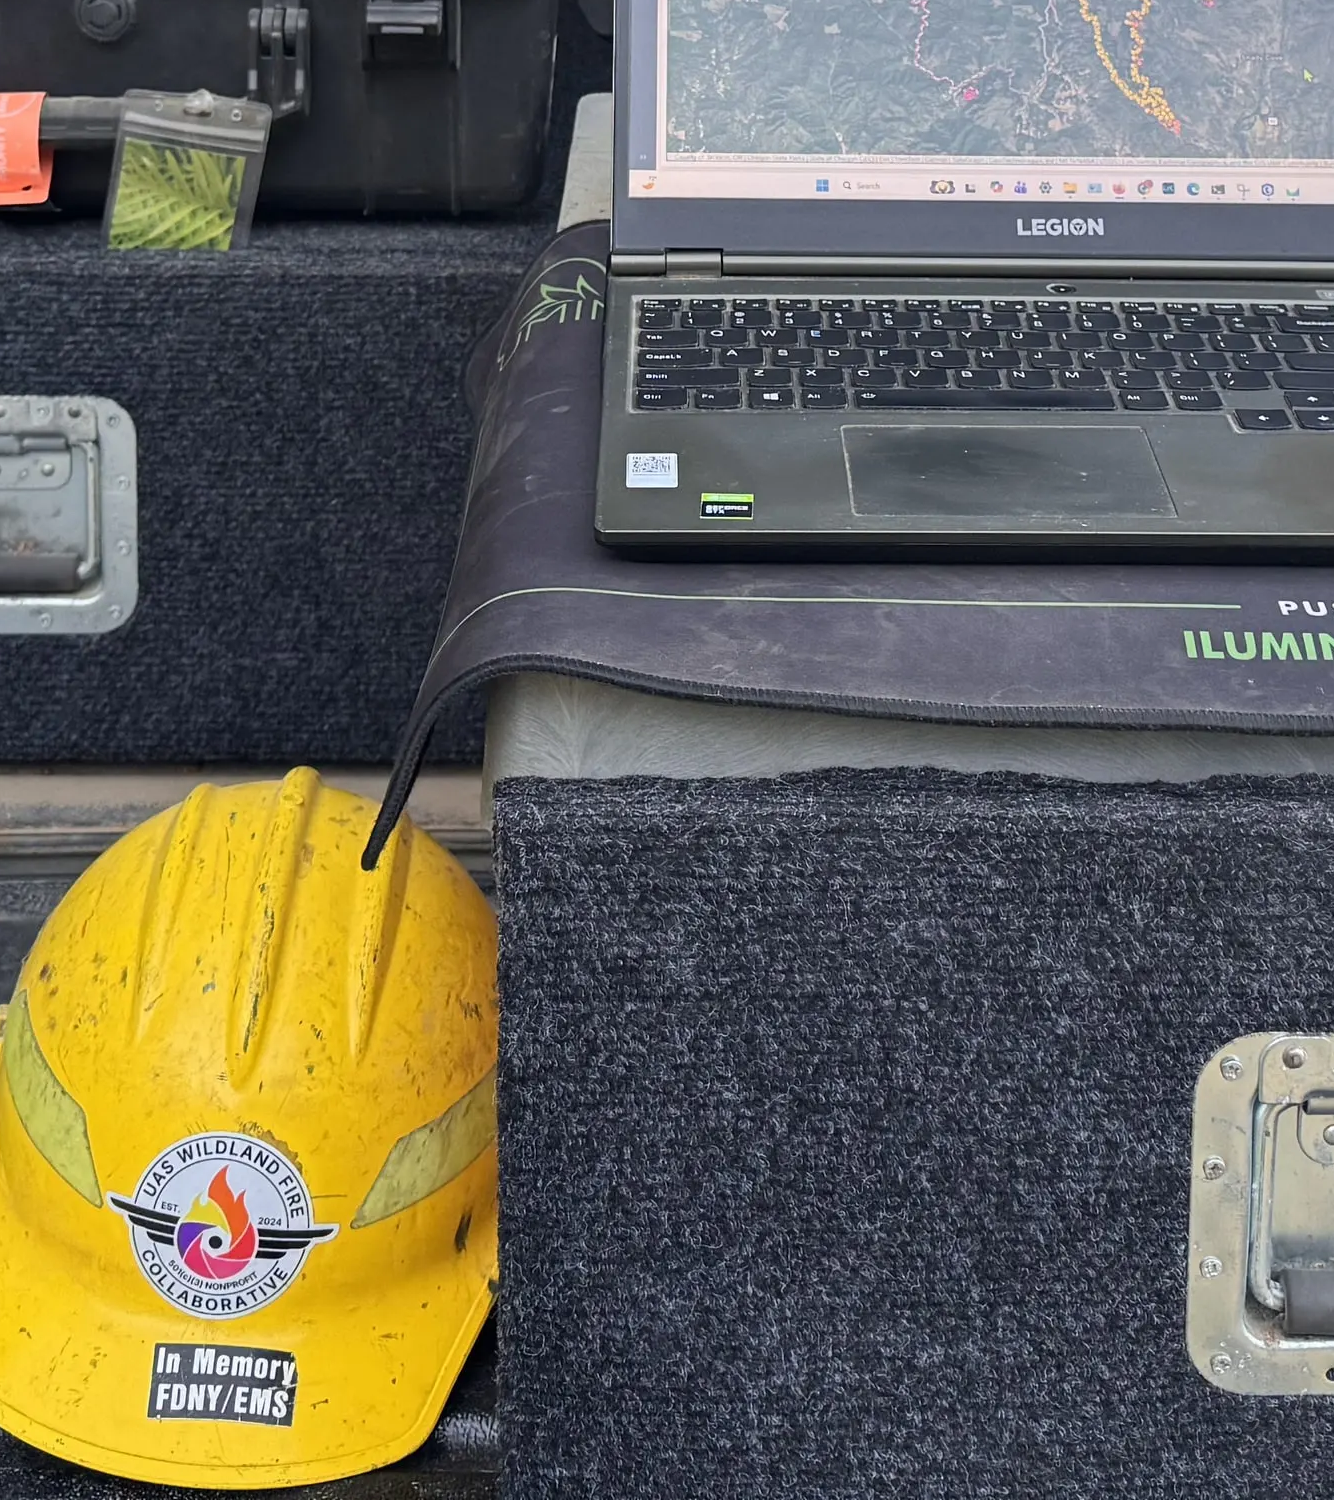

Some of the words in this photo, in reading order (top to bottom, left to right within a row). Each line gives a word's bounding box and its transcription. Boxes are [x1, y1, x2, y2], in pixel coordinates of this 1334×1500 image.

[856, 181, 880, 190] Search
[1017, 218, 1104, 236] LEGION
[144, 1160, 174, 1197] UAS
[176, 1140, 280, 1176] WILDLAND
[278, 1176, 305, 1219] FIRE
[161, 1201, 181, 1213] EST.
[258, 1217, 282, 1227] 2024
[142, 1250, 288, 1311] COLLABORATIVE
[205, 1271, 258, 1291] NONPROFIT
[156, 1347, 181, 1374] In
[192, 1348, 296, 1386] Memory
[156, 1383, 290, 1418] FDNY/EMS
